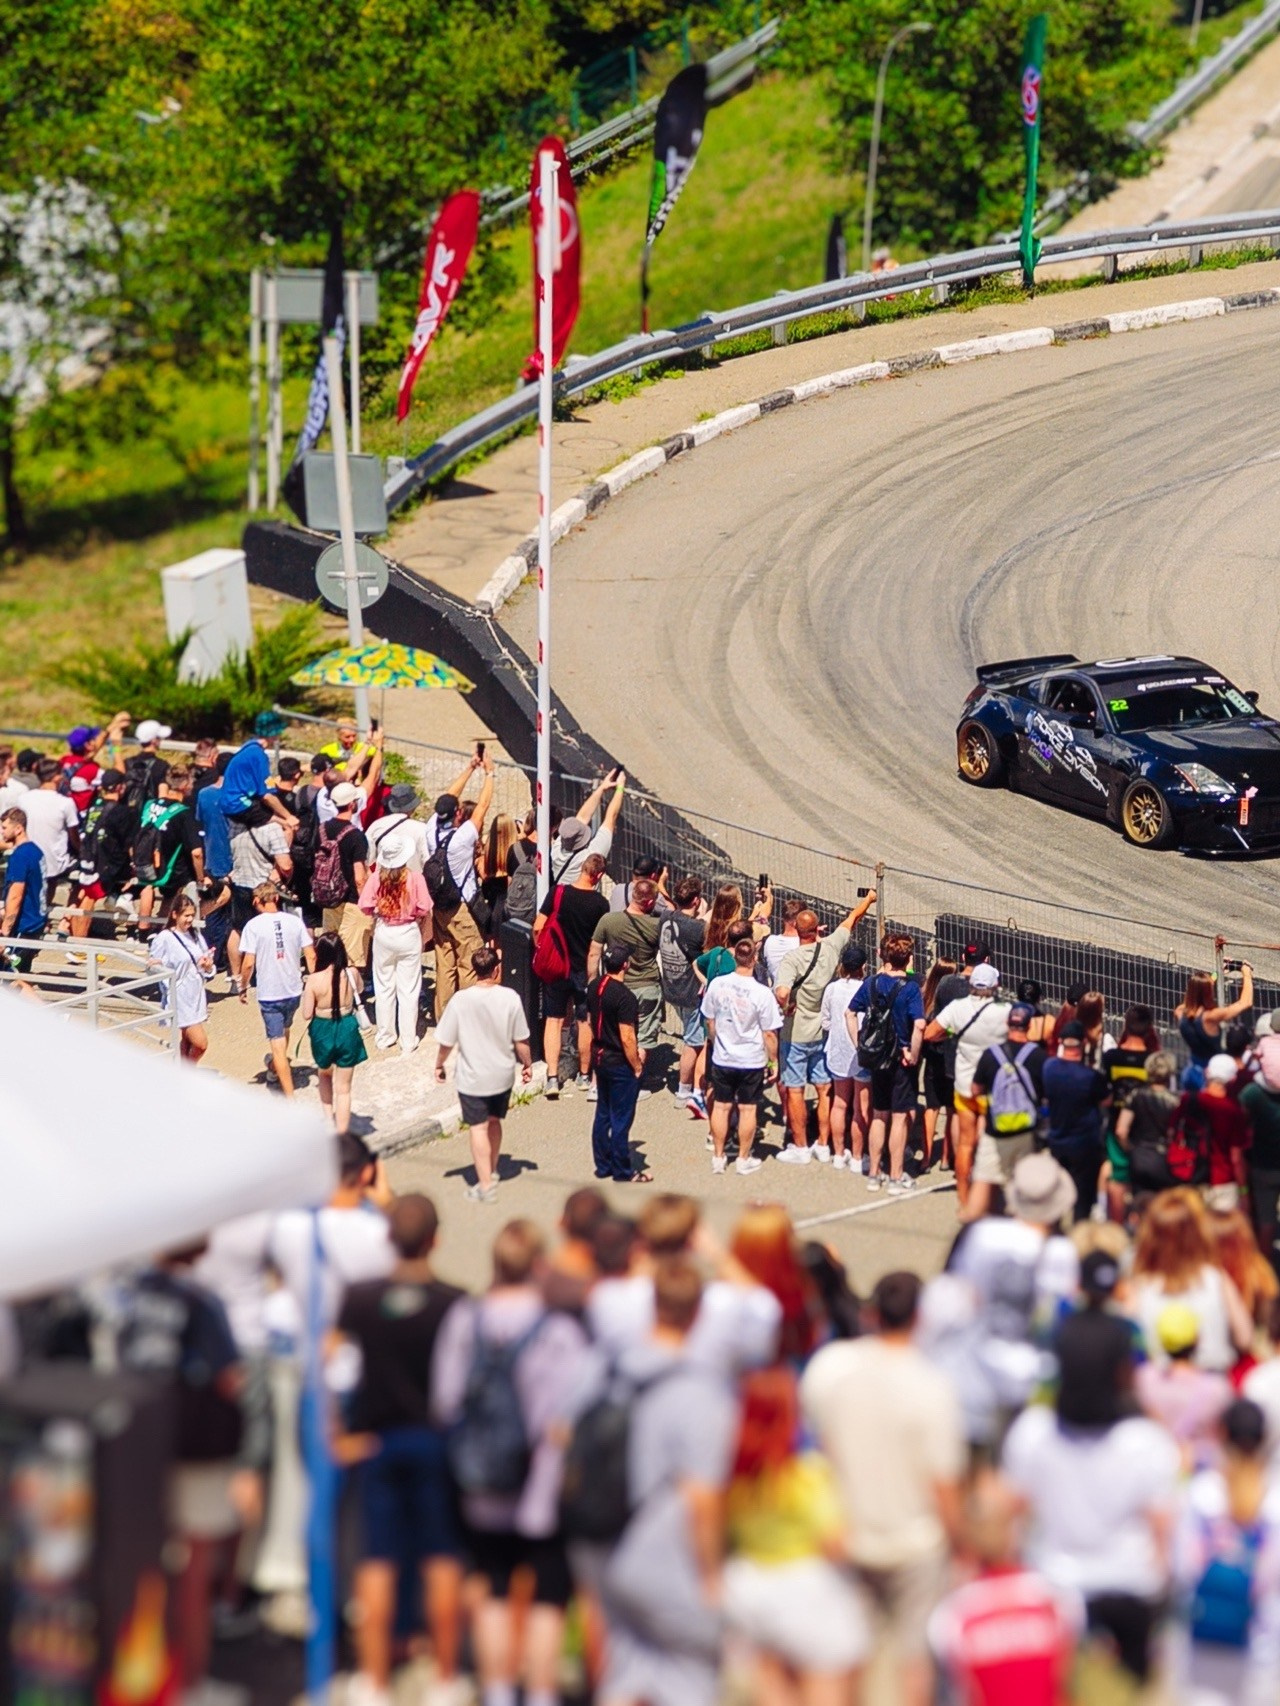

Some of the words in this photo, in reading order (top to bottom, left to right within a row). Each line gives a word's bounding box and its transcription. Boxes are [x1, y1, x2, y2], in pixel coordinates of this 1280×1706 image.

[1109, 699, 1130, 712] 22
[1033, 711, 1066, 754] FORCE
[1063, 749, 1110, 798] DIVISION
